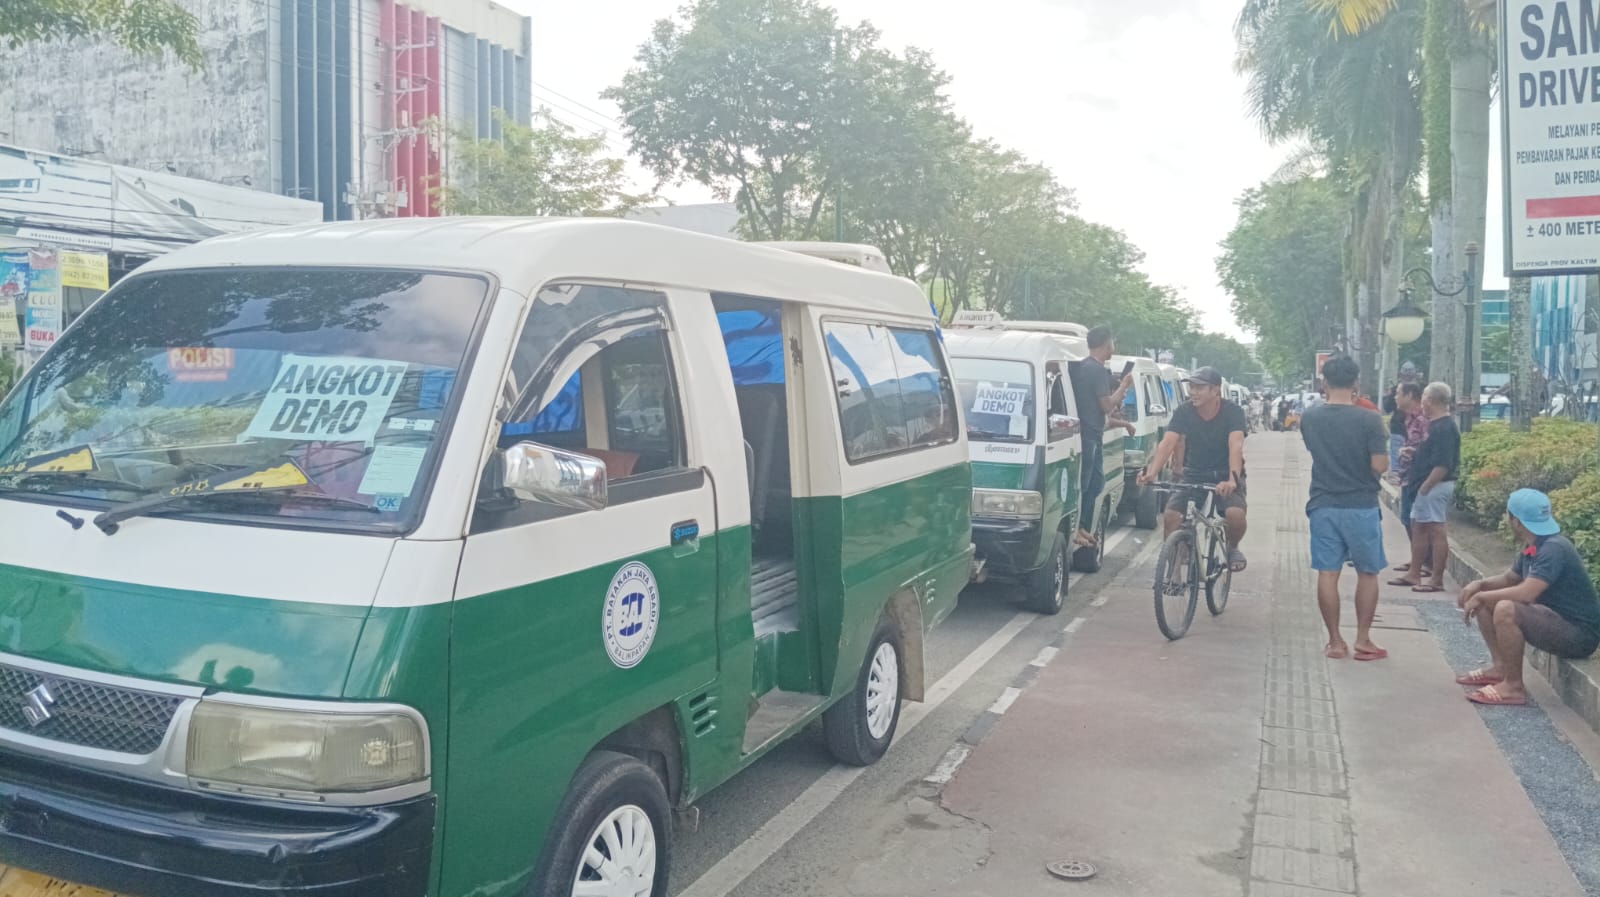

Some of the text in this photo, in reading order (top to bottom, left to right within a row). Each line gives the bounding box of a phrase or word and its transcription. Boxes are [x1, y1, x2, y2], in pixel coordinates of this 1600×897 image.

[1519, 66, 1600, 108] DRIVE
[1548, 123, 1588, 139] MELAYANI
[1516, 148, 1564, 164] PEMBAYARAN
[1566, 146, 1589, 161] PAJAK
[1555, 171, 1570, 185] DAN
[1538, 222, 1561, 236] 400
[1570, 258, 1597, 266] KALTIM
[30, 330, 54, 342] BUKA
[271, 363, 406, 396] ANGKOT
[978, 389, 1025, 401] ANGKOT
[981, 399, 1015, 413] DEMO
[269, 398, 367, 434] DEMO
[376, 497, 397, 508] OK
[606, 570, 632, 616] BATAKAN
[634, 569, 650, 585] JAYA
[648, 586, 657, 622] ABADI
